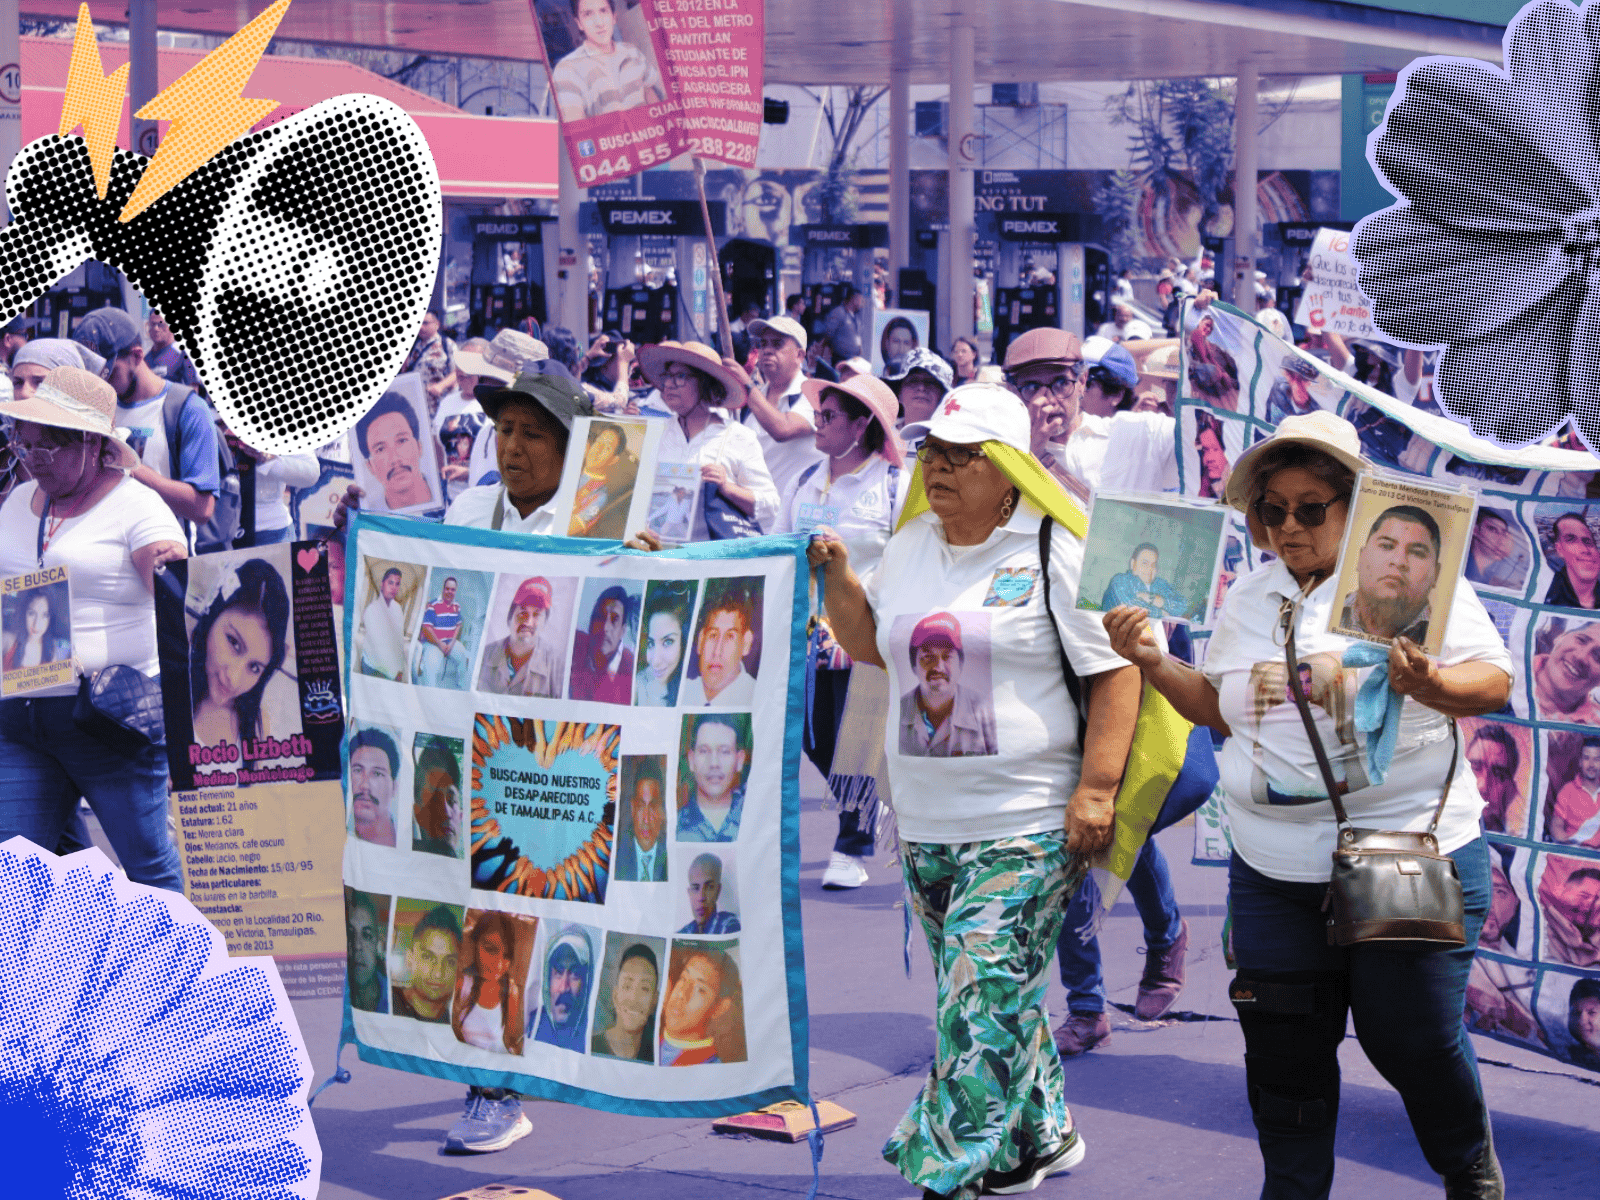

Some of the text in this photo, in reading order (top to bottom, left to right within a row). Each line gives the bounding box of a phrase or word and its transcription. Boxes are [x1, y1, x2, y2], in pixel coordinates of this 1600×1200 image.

[688, 15, 712, 28] DEL
[713, 13, 754, 28] METRO
[669, 32, 732, 46] PANTITLAN
[732, 47, 748, 61] DE
[708, 64, 728, 78] DEL
[730, 65, 749, 79] IPN
[598, 125, 665, 151] BUSCANDO
[579, 155, 631, 183] 044
[638, 143, 671, 166] 55
[1009, 196, 1047, 211] TUT
[610, 210, 673, 225] PEMEX
[1004, 220, 1058, 233] PEMEX
[808, 229, 851, 241] PEMEX
[1286, 228, 1317, 240] PEM
[4, 566, 66, 592] SE BUSCA
[24, 664, 48, 678] LIZBETH
[188, 734, 313, 766] Rocio Lizbeth
[193, 764, 315, 787] Medina Montelongo
[489, 766, 601, 791] BUSCANDO NUESTROS
[177, 790, 236, 803] Sexo: Femenino
[504, 785, 590, 807] DESAPARECIDOS
[179, 801, 259, 815] Edad actual: 21 años
[494, 801, 508, 814] DE
[510, 803, 576, 822] TAMAULIPAS
[181, 814, 234, 828] Estatura: 1.62
[224, 827, 245, 838] clara
[184, 842, 204, 853] Ojos:
[259, 837, 286, 848] oscuro
[186, 854, 216, 865] Cabello:
[239, 852, 262, 864] negro
[187, 860, 314, 877] Fecha de Nacimiento: 15/03/95
[210, 878, 262, 891] particulares:
[190, 892, 203, 903] Dos
[227, 890, 238, 900] en
[240, 889, 248, 898] la
[233, 916, 244, 927] en
[244, 915, 253, 926] la
[253, 913, 291, 926] Localidad
[224, 929, 235, 940] de
[235, 928, 266, 939] Victoria,
[227, 939, 275, 954] ayo de 2013
